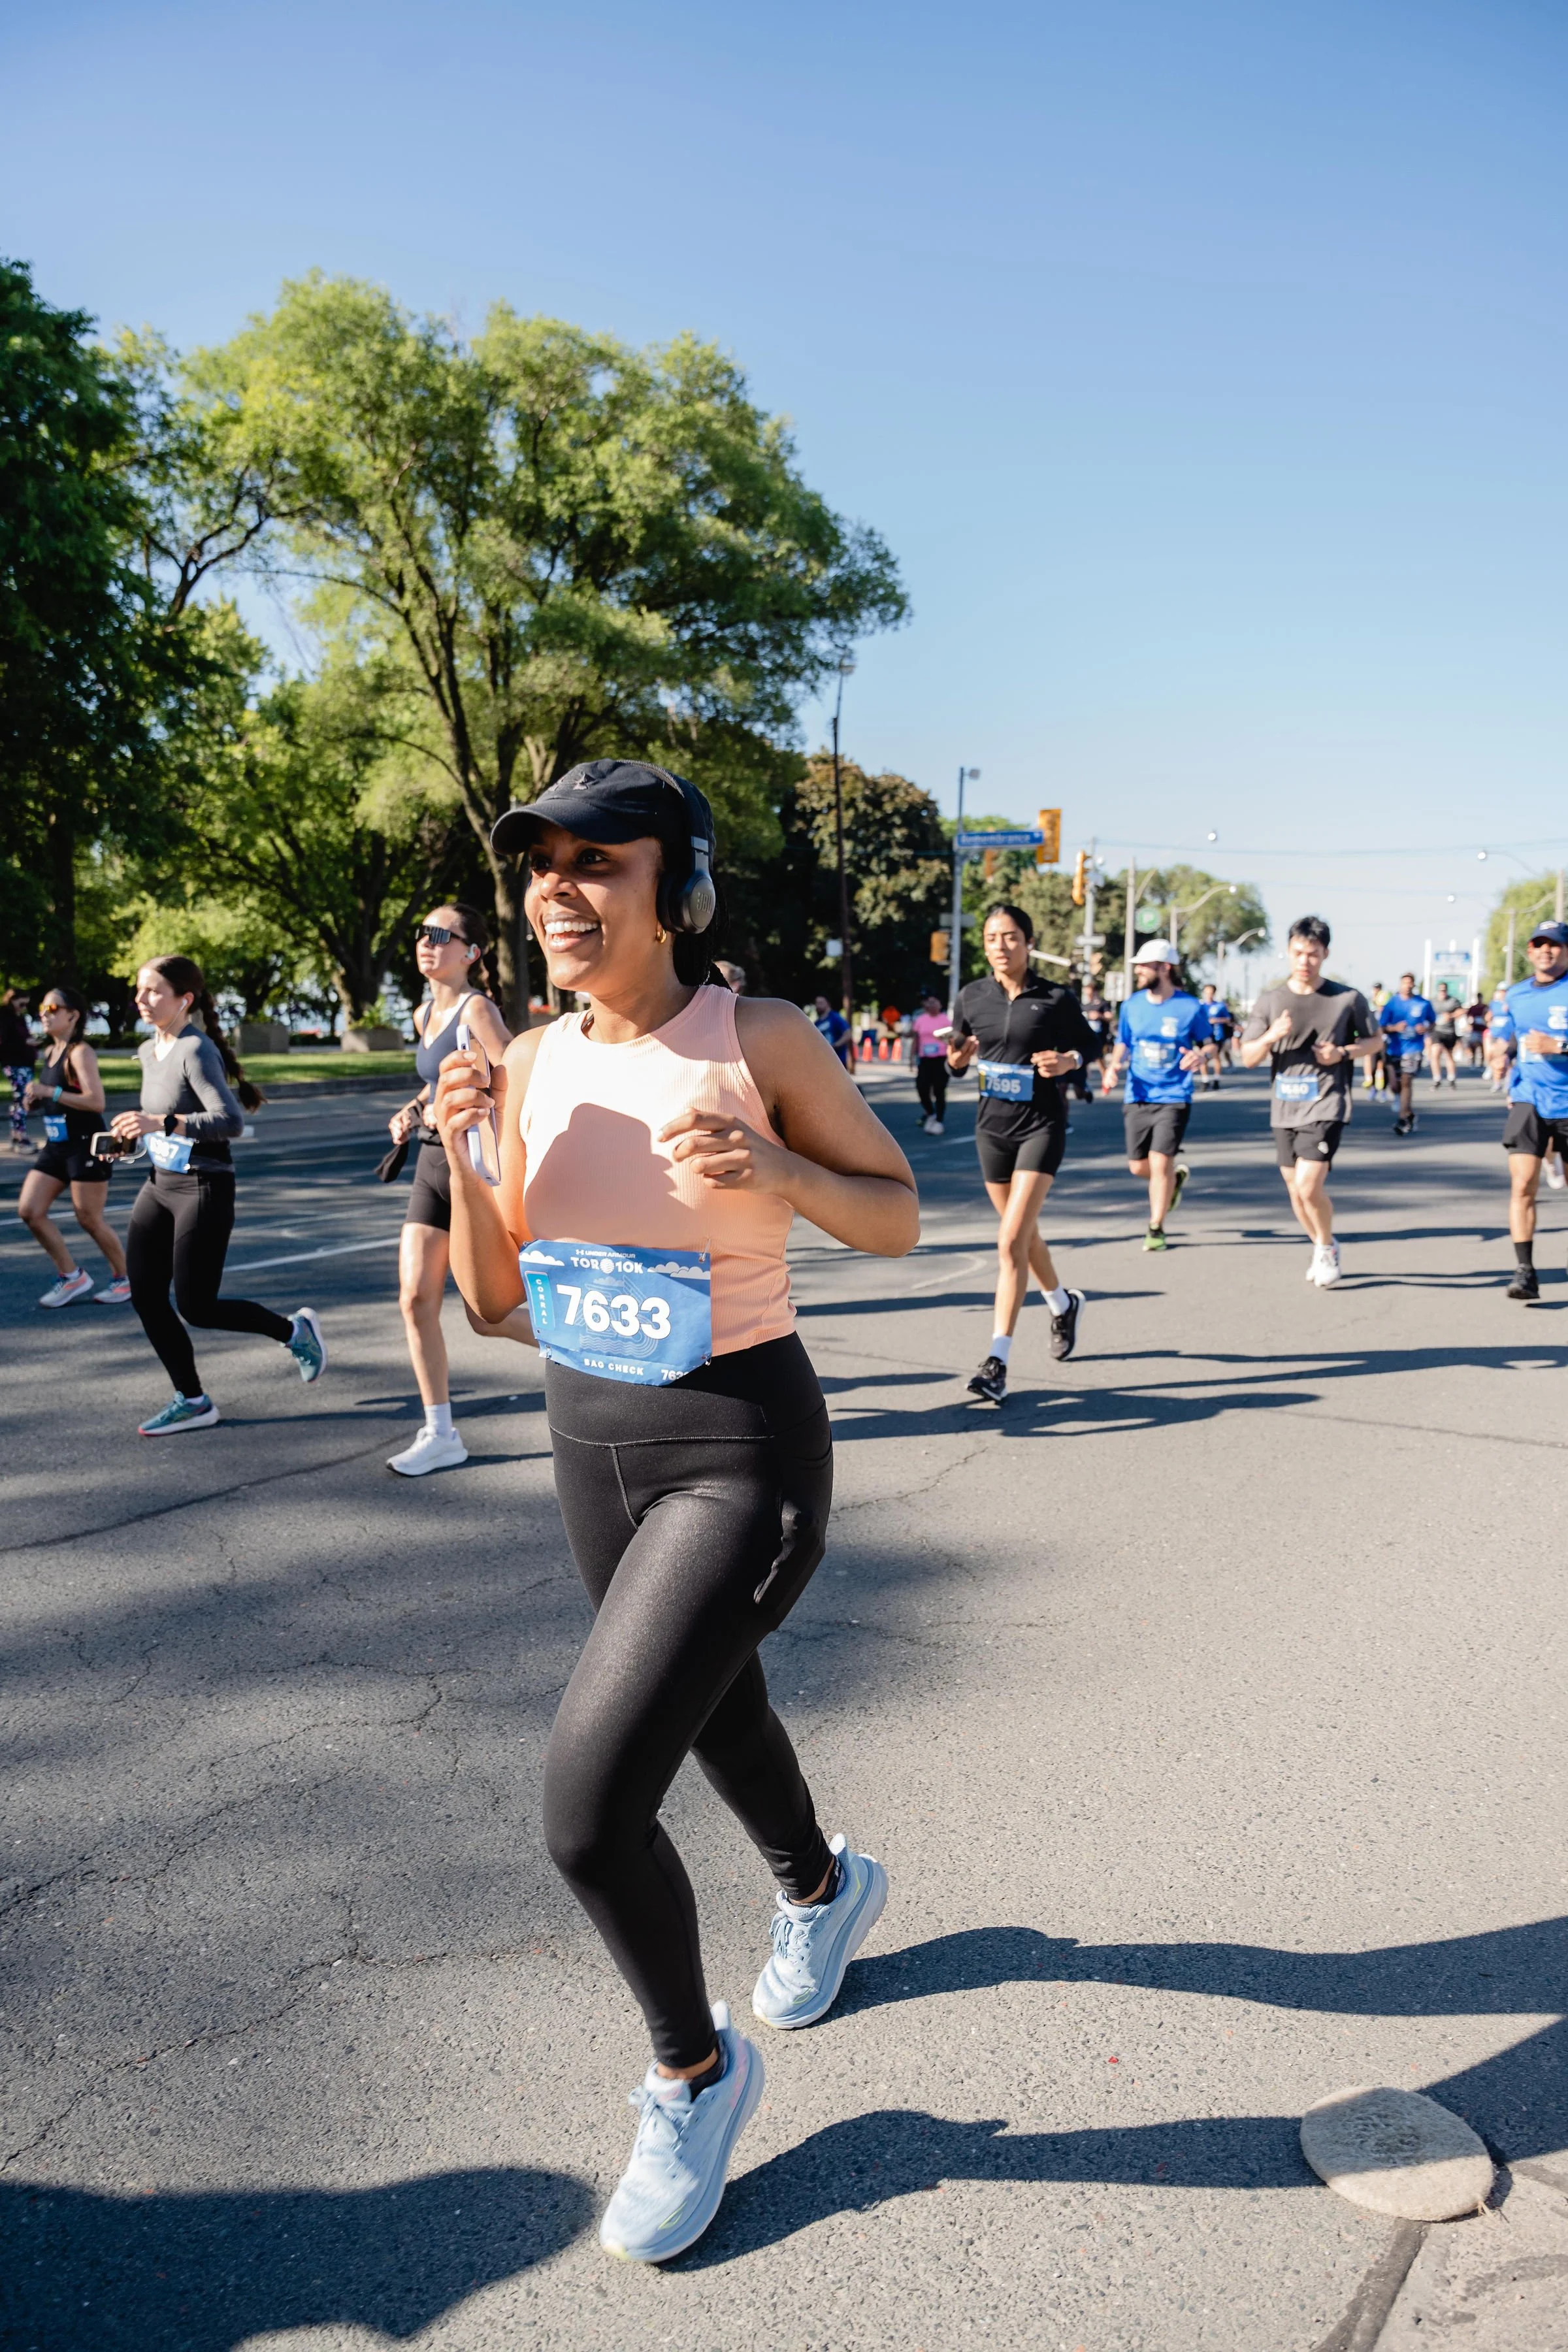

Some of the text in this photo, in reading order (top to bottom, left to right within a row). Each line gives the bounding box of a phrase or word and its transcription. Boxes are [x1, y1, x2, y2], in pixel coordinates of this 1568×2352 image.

[696, 892, 712, 914] JBL
[536, 1279, 548, 1325] CORRAL
[556, 1284, 672, 1339] 7633
[583, 1358, 644, 1376] BAG CHECK
